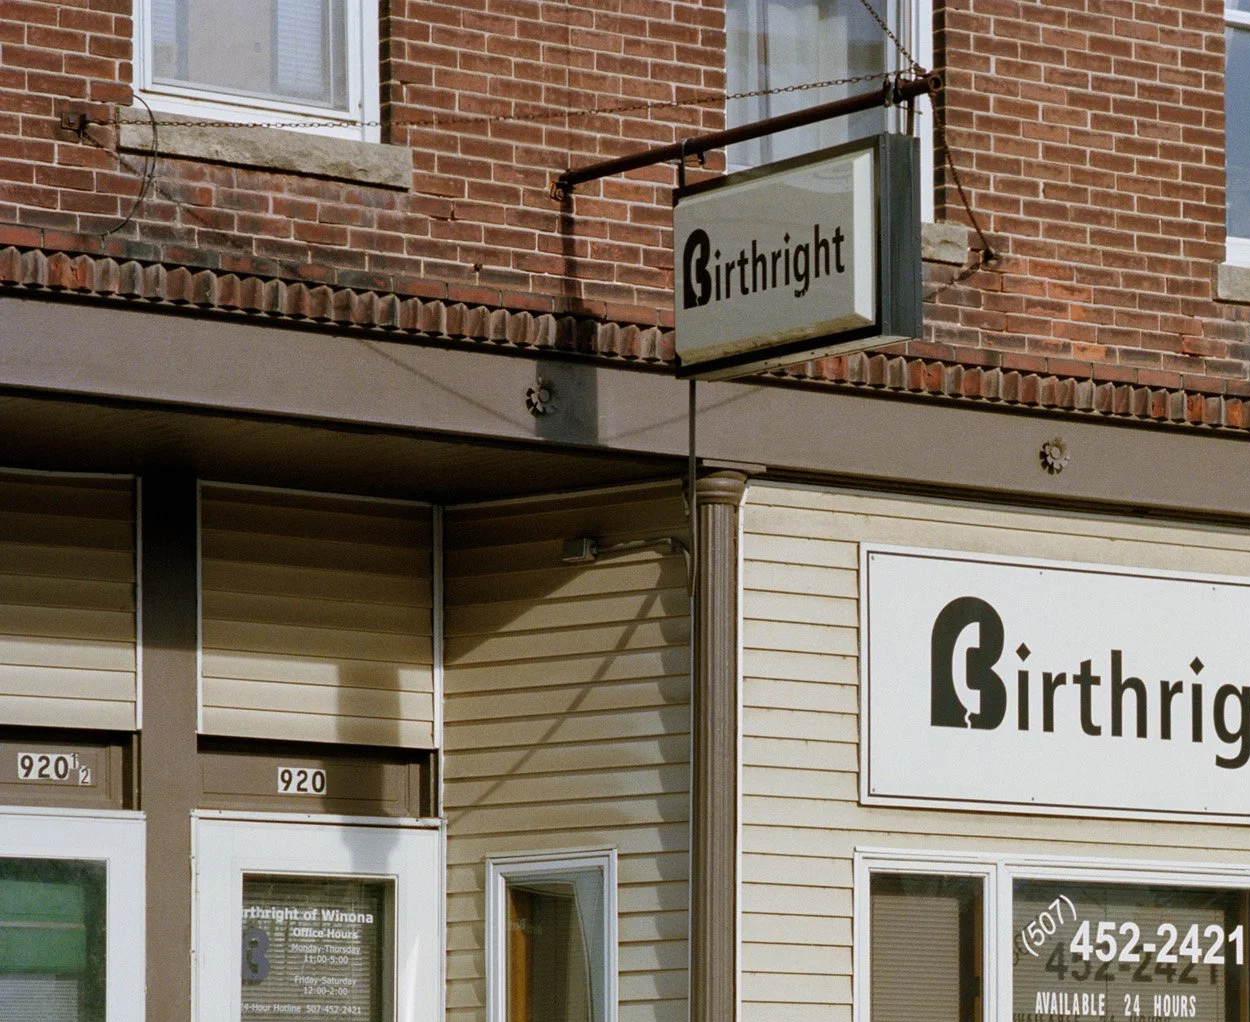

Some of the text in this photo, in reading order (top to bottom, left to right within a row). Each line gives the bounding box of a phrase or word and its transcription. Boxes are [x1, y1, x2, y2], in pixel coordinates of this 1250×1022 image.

[683, 223, 846, 310] Birthright
[280, 769, 326, 793] 920
[243, 906, 374, 924] rthright of Winona
[293, 927, 359, 939] Office Hours
[1022, 894, 1244, 965] (507) 452-2421
[1035, 991, 1197, 1018] AVAILABLE 24 HOURS
